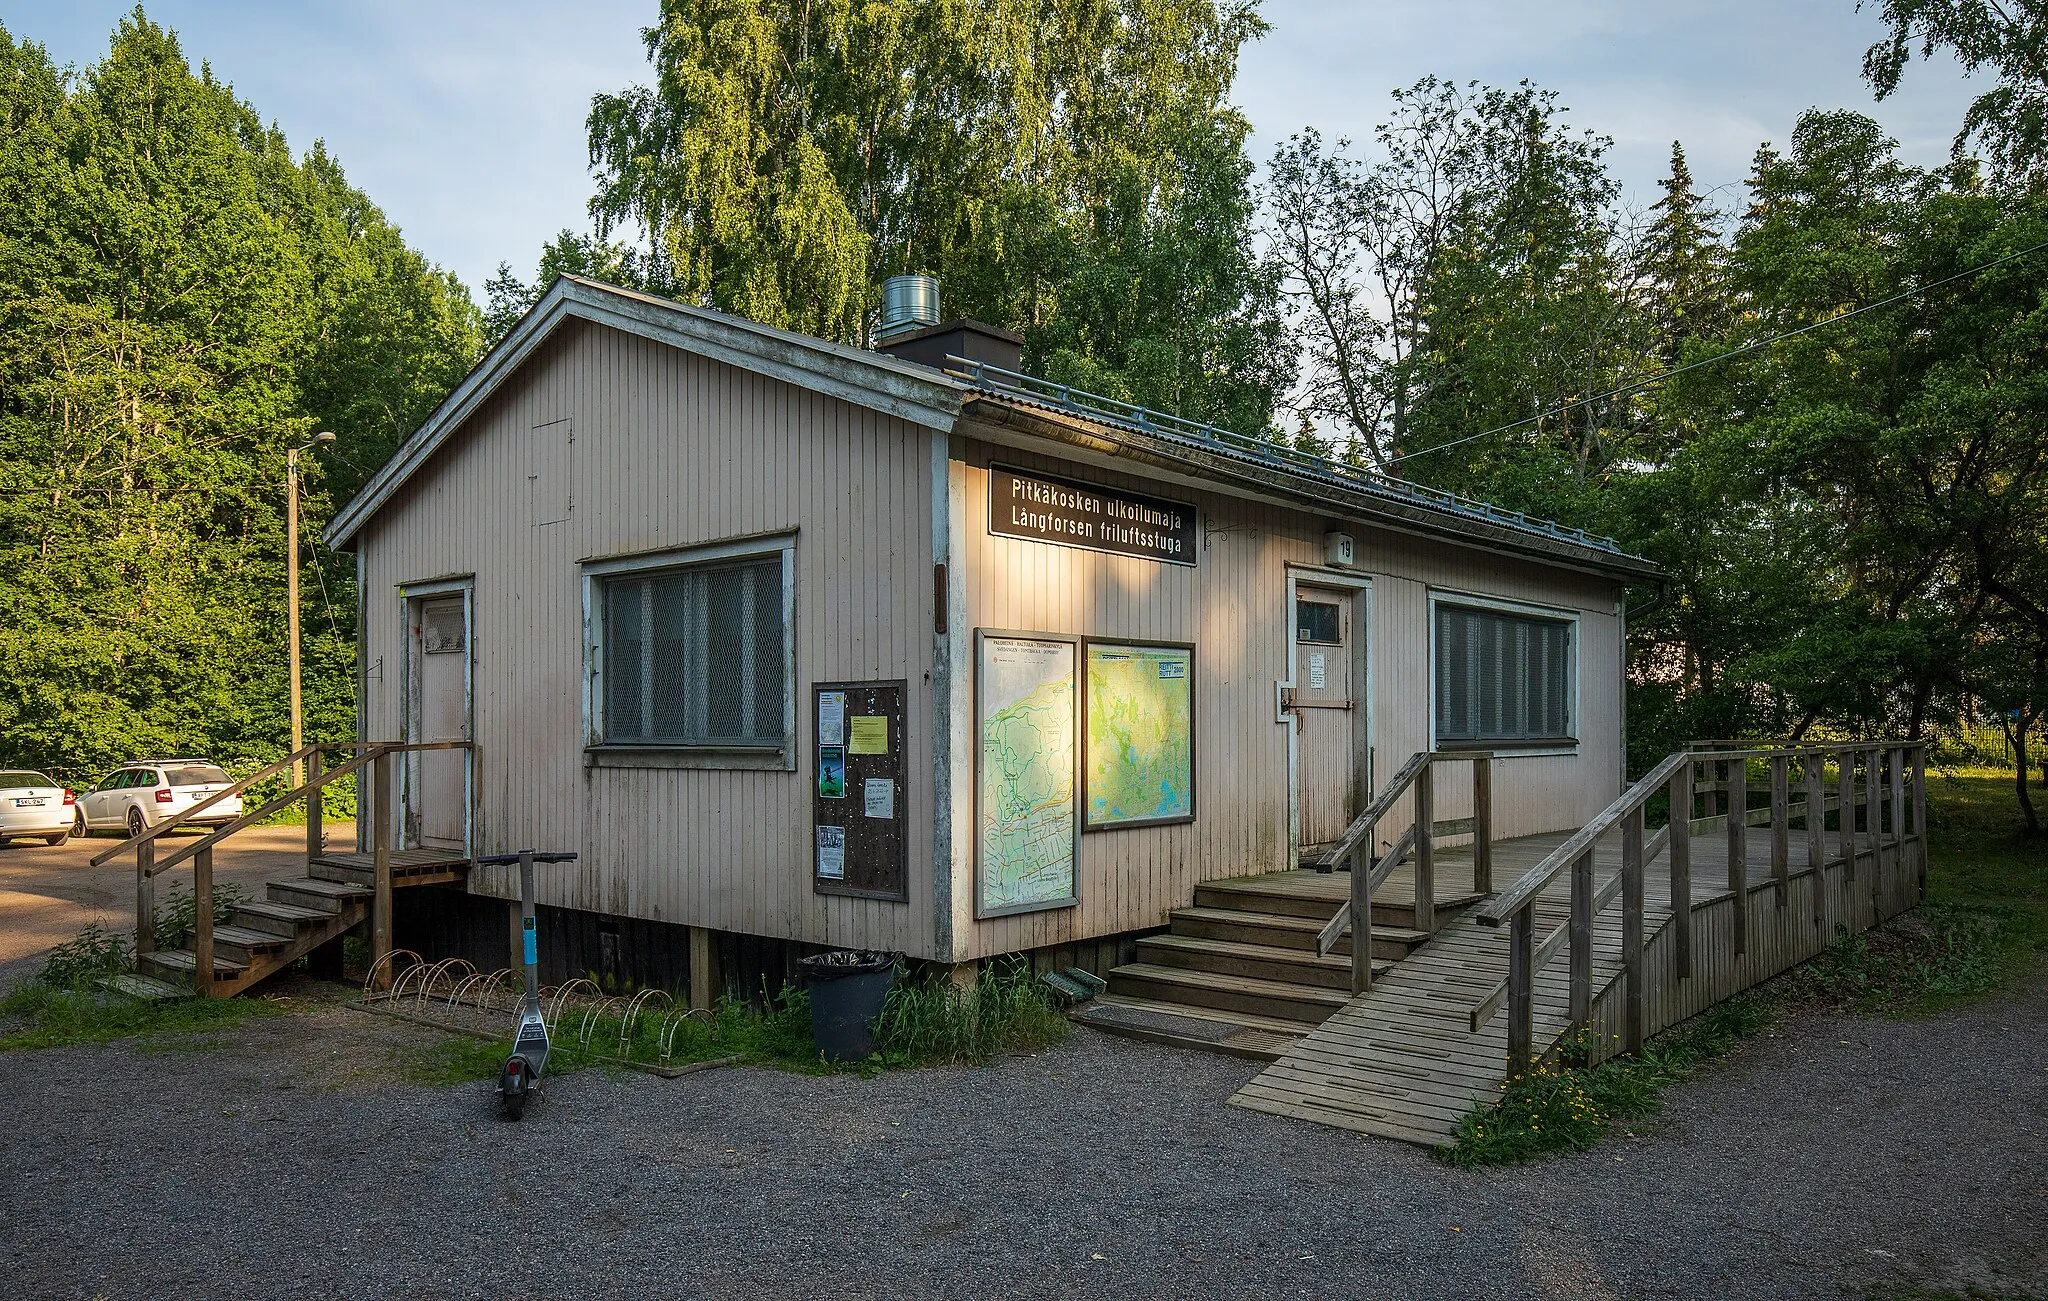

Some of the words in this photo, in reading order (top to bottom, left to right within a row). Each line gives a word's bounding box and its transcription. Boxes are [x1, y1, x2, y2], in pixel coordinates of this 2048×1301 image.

[1012, 478, 1100, 514] Pitkäkosken
[1107, 500, 1181, 531] ulkoilumaja
[1012, 505, 1093, 538] Långforsen
[1100, 521, 1181, 554] friluftsstuga
[1340, 541, 1350, 558] 19
